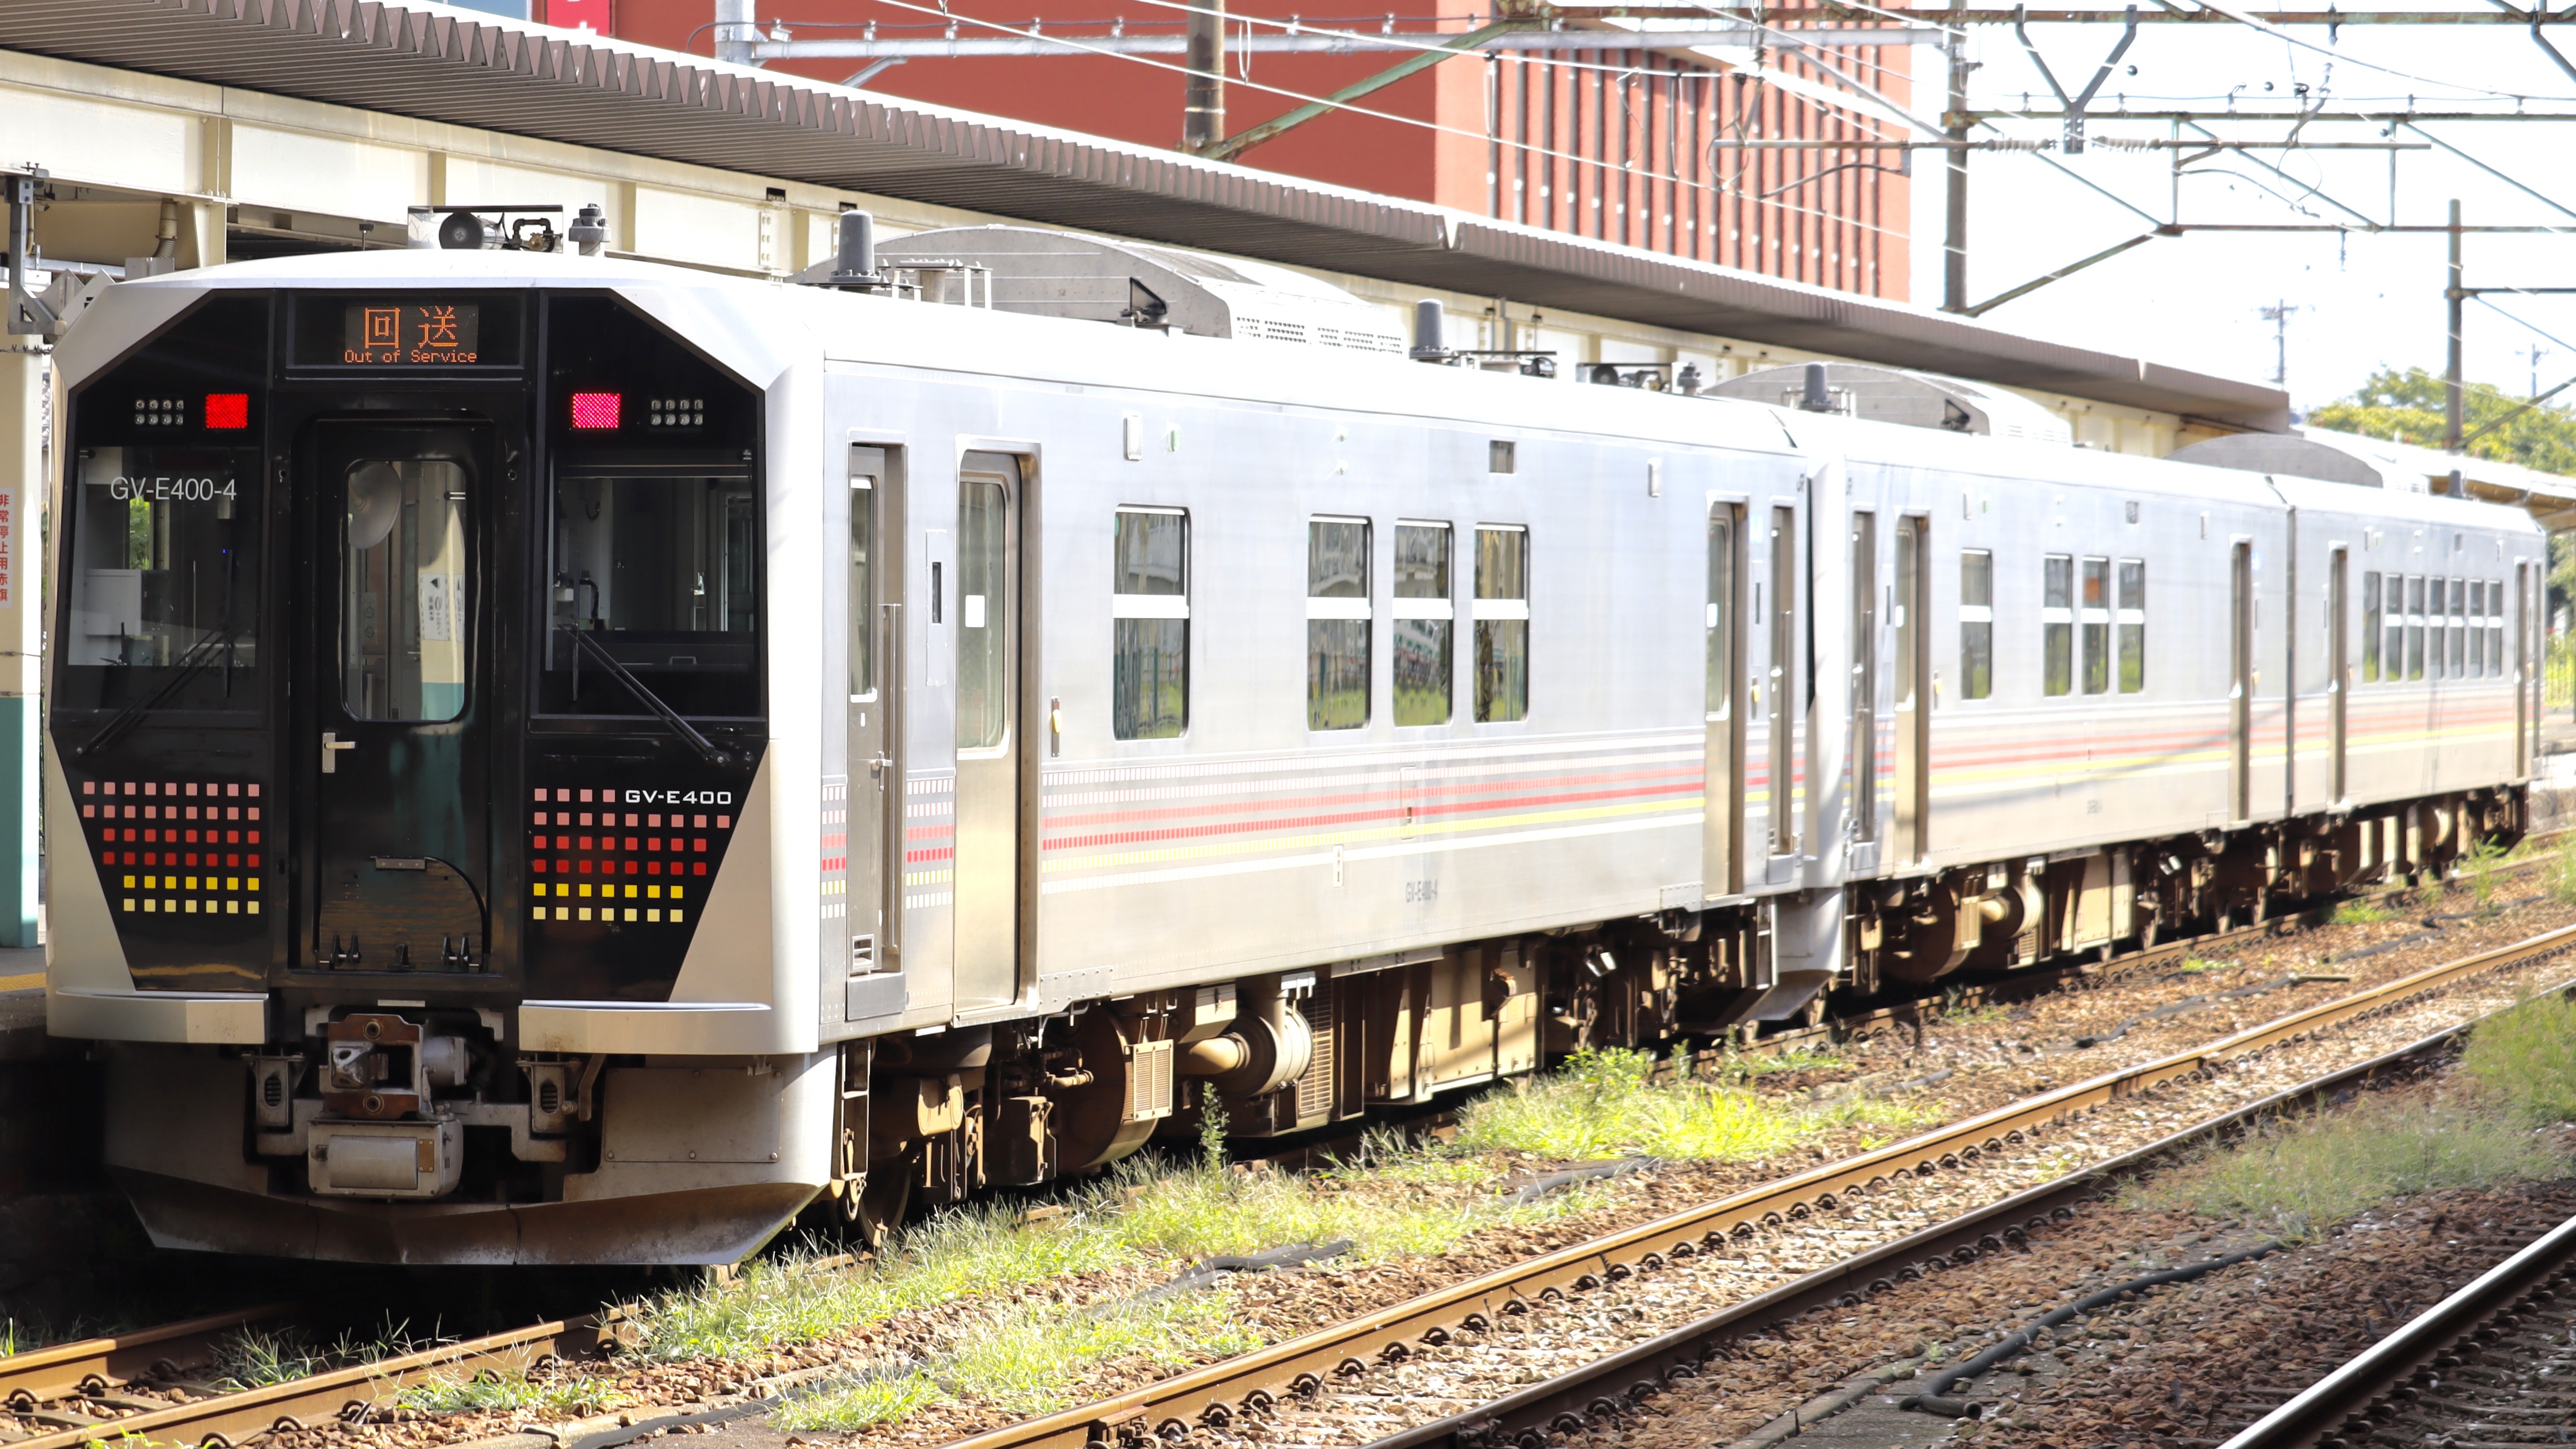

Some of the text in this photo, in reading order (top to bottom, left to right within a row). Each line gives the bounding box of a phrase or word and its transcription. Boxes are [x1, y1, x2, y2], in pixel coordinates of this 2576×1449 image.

[364, 305, 459, 349] 回送
[345, 349, 477, 363] Out of Service
[110, 476, 237, 501] GV-E400-4
[625, 790, 732, 805] GV-E400
